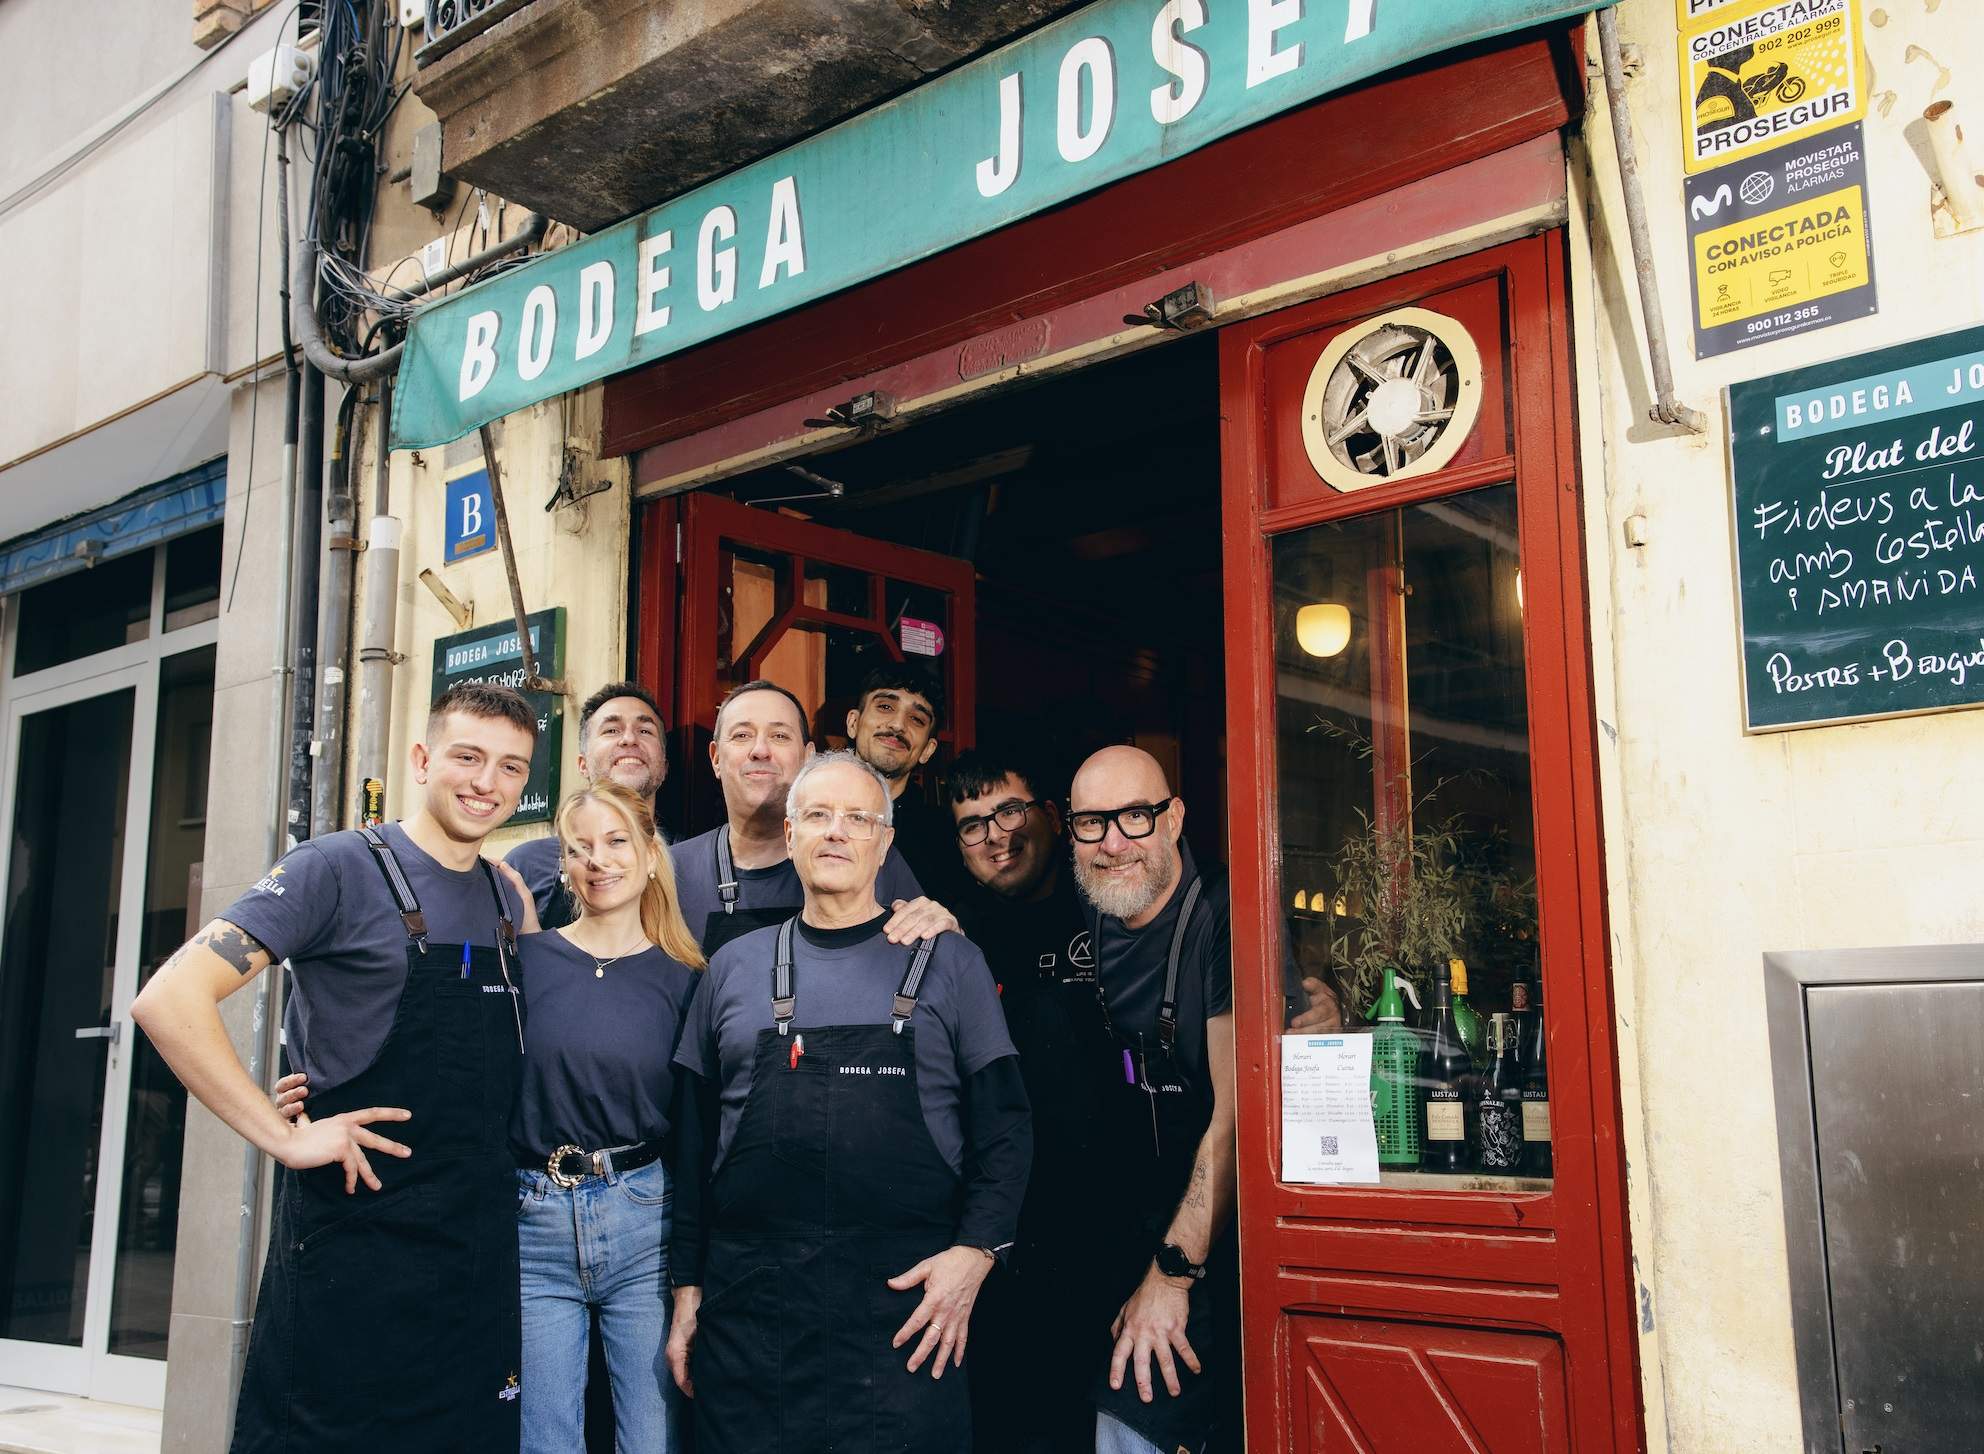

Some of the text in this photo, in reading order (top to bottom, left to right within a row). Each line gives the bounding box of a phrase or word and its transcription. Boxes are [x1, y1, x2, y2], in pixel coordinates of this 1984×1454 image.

[1692, 0, 1842, 53] CONECTAD
[1693, 2, 1843, 61] CON CENTRAL DE ALARMAS
[1759, 17, 1840, 54] 902 202 999
[1697, 92, 1849, 156] PROSEGUR
[1786, 141, 1852, 171] MOVISTAR
[1786, 151, 1859, 182] PROSEGUR
[1788, 169, 1845, 194] ALARMAS
[1706, 206, 1850, 260] CONECTADA
[1707, 225, 1852, 275] CON AVISO A POLICÍA
[459, 176, 806, 402] BODEGA
[1747, 305, 1819, 333] 900 112 365
[1786, 380, 1913, 429] BODEGA
[1822, 420, 1975, 479] Plat del
[1910, 488, 1938, 511] a
[1950, 473, 1984, 507] la
[461, 493, 482, 537] B
[1770, 542, 1852, 583] amb
[448, 633, 536, 668] BODEGA JOSEA
[840, 1066, 906, 1076] BODEGA JOSEFA
[1431, 1090, 1459, 1098] LUSTAU
